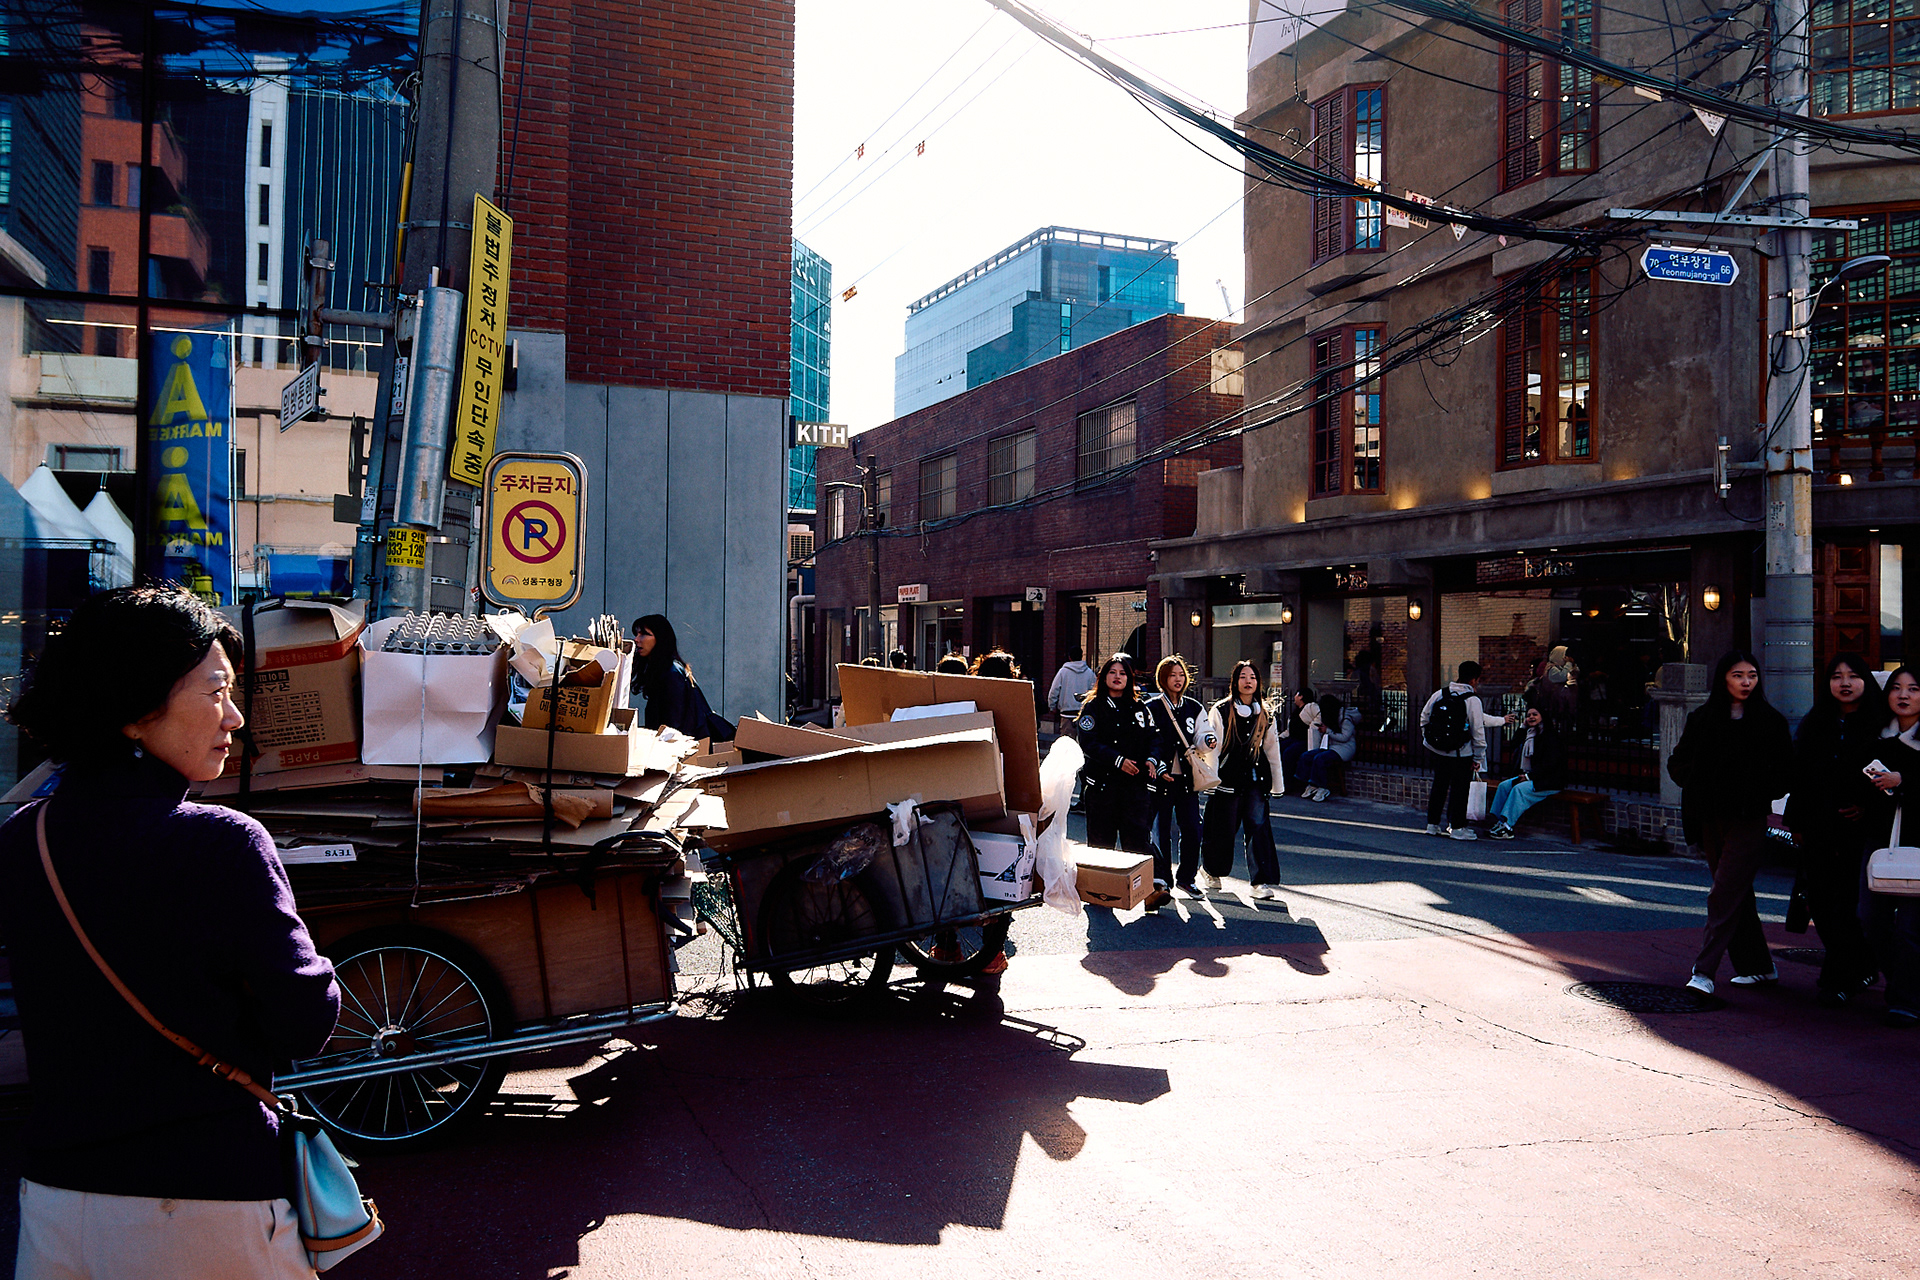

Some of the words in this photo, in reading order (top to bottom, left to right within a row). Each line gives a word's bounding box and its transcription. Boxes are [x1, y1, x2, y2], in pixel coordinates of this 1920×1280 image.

[1649, 258, 1660, 268] 70
[1669, 254, 1711, 270] 연무장길
[1720, 265, 1731, 275] 66
[480, 211, 502, 332] 불법주정차
[1660, 267, 1720, 281] Yeonmujang-gil
[470, 329, 502, 358] CCTV
[283, 374, 313, 421] 일방통행
[463, 356, 493, 475] 무인단속중
[797, 424, 846, 445] KITH
[500, 474, 571, 495] 주차금지
[388, 530, 407, 542] 현대
[522, 577, 563, 587] 성동구청장
[1186, 717, 1195, 734] S
[324, 849, 352, 857] TEYS
